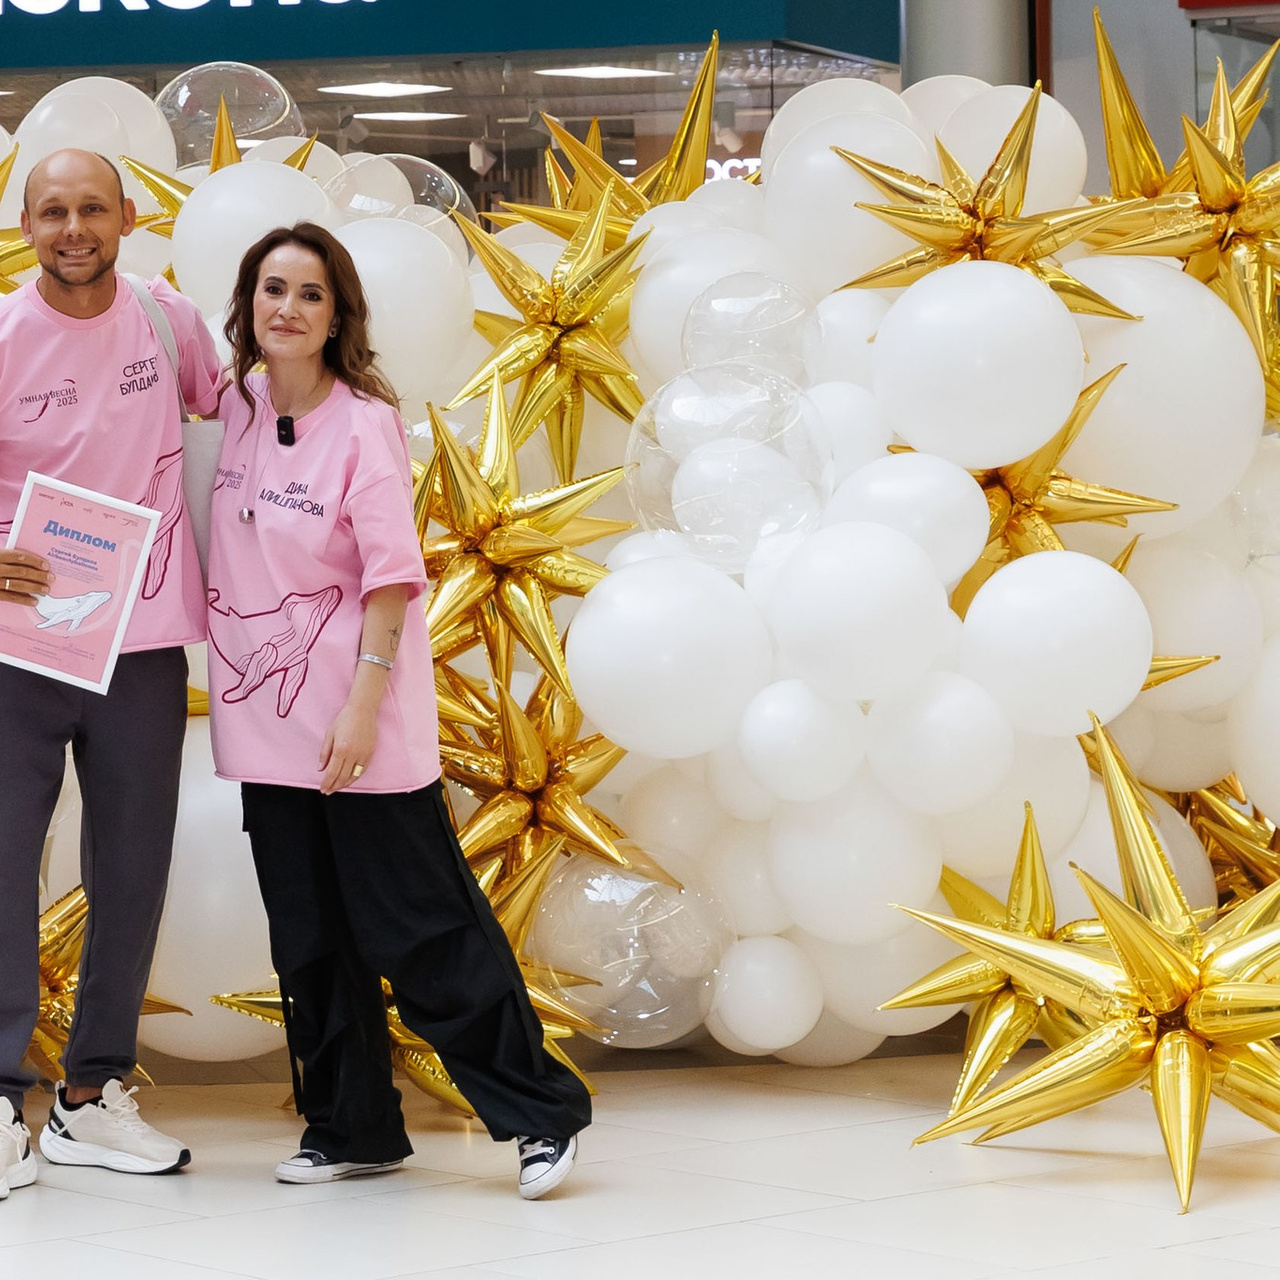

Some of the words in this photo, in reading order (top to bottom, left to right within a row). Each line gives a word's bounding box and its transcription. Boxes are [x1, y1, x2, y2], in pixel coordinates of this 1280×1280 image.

[19, 392, 49, 405] УМНАЯ
[50, 387, 77, 399] ВЕСНА
[56, 395, 78, 407] 2025
[284, 481, 309, 495] ДИНА
[43, 519, 117, 553] Диплом
